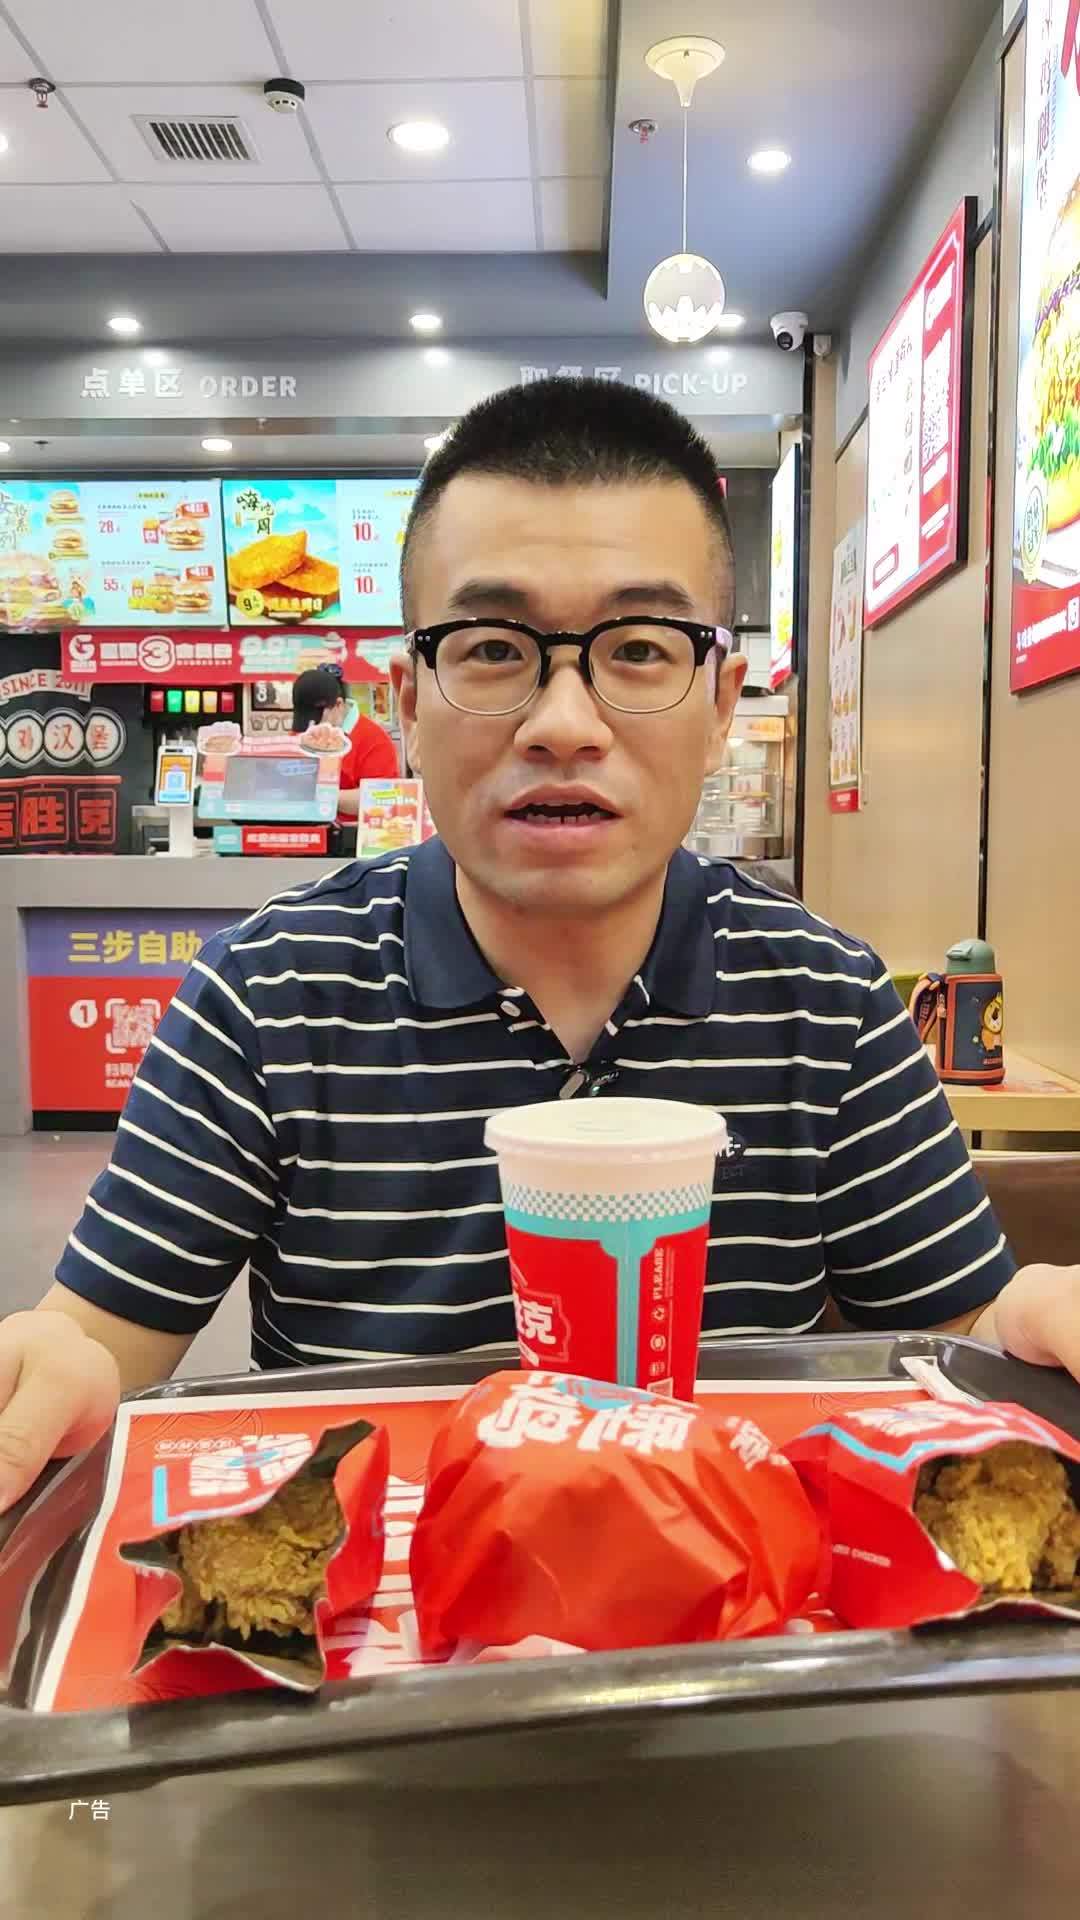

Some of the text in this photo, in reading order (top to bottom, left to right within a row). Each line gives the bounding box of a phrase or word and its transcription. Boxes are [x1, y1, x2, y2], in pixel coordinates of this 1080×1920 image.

[80, 367, 298, 399] 点单区 ORDER
[634, 373, 748, 395] PICK-UP
[353, 522, 372, 542] 10
[356, 575, 374, 594] 10
[2, 673, 47, 697] SINCE
[68, 930, 203, 964] 三步自助
